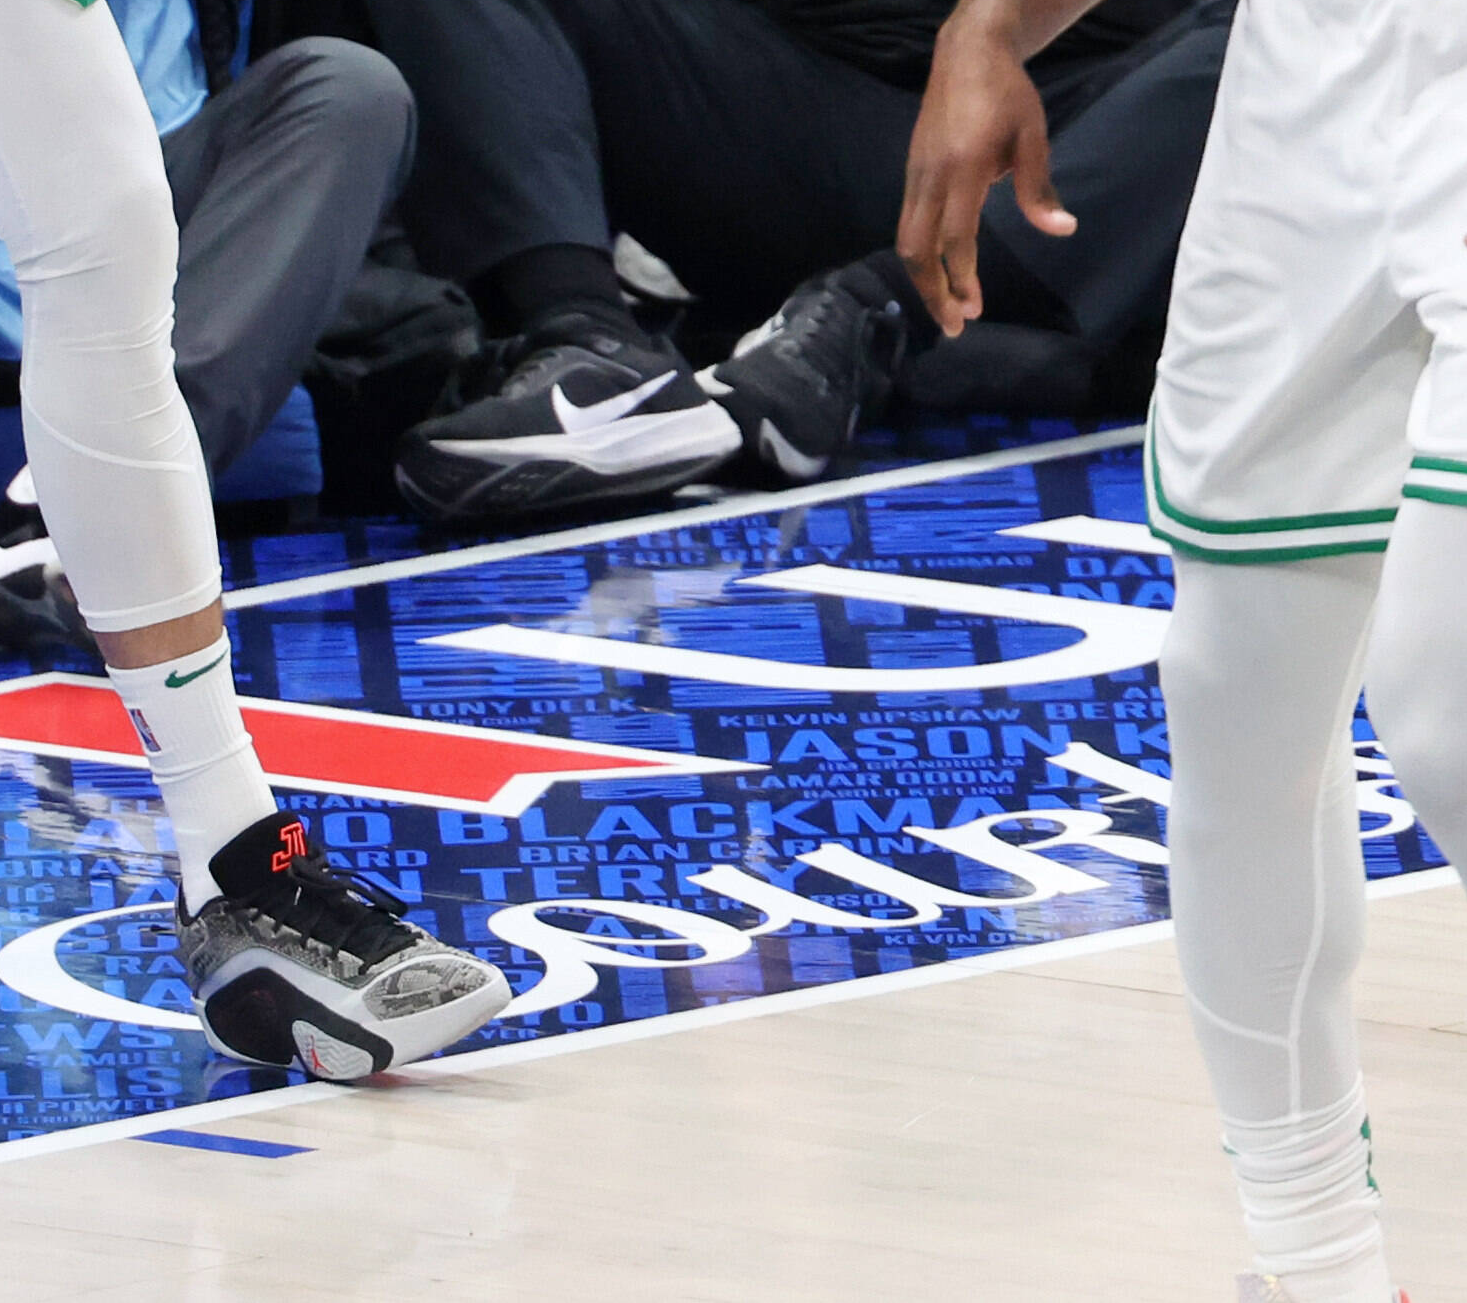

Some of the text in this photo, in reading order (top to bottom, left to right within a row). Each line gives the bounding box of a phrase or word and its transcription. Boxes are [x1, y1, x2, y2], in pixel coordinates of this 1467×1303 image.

[411, 699, 515, 718] TONY
[719, 707, 1021, 728] KELVIN UPSHAW
[740, 725, 1069, 764] JASON
[735, 769, 1015, 791] LAMAR ODOM
[518, 841, 690, 864] BRIAN
